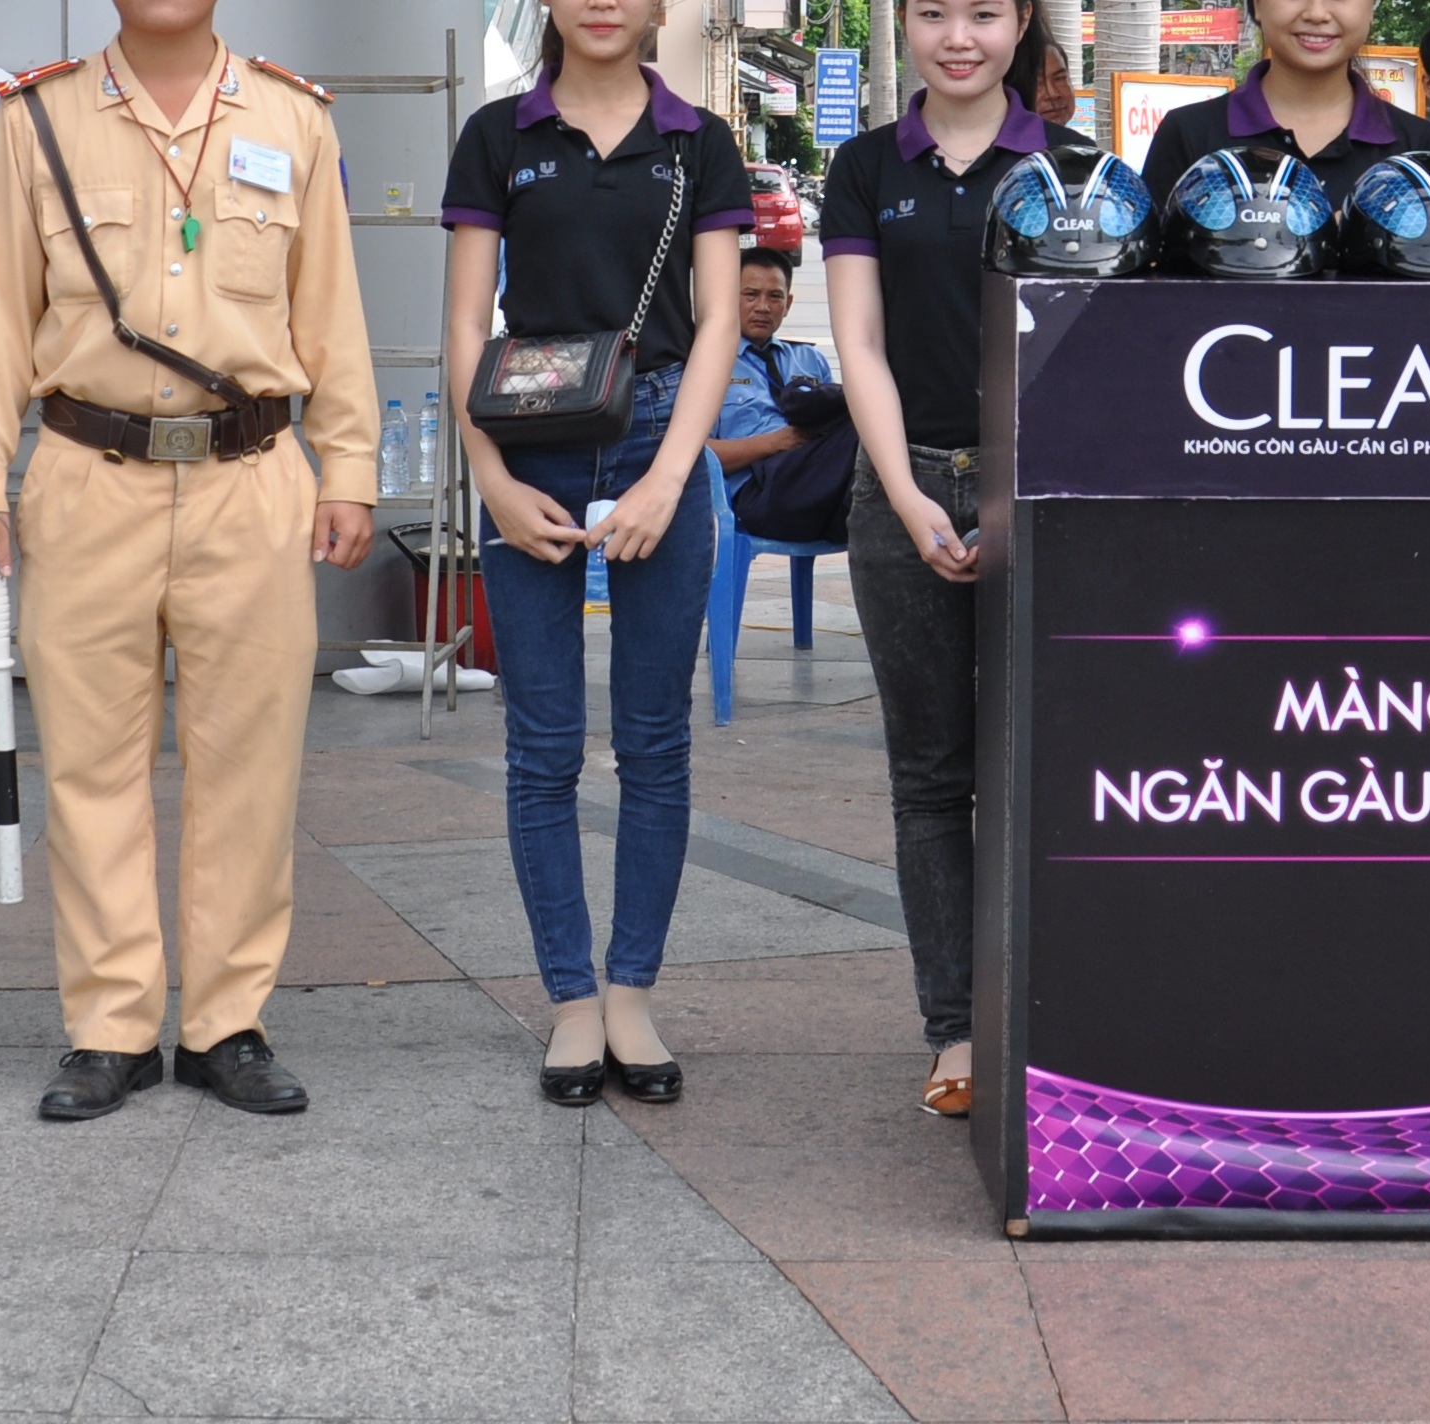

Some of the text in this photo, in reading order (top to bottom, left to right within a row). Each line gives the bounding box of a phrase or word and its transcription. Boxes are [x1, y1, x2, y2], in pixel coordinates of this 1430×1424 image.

[1053, 216, 1095, 232] CLEAR
[1239, 208, 1281, 225] CLEAR
[1183, 436, 1251, 455] KHÔNG
[1254, 437, 1295, 455] CÒN
[1389, 437, 1409, 455] GÌ
[1094, 758, 1282, 823] NGĂN
